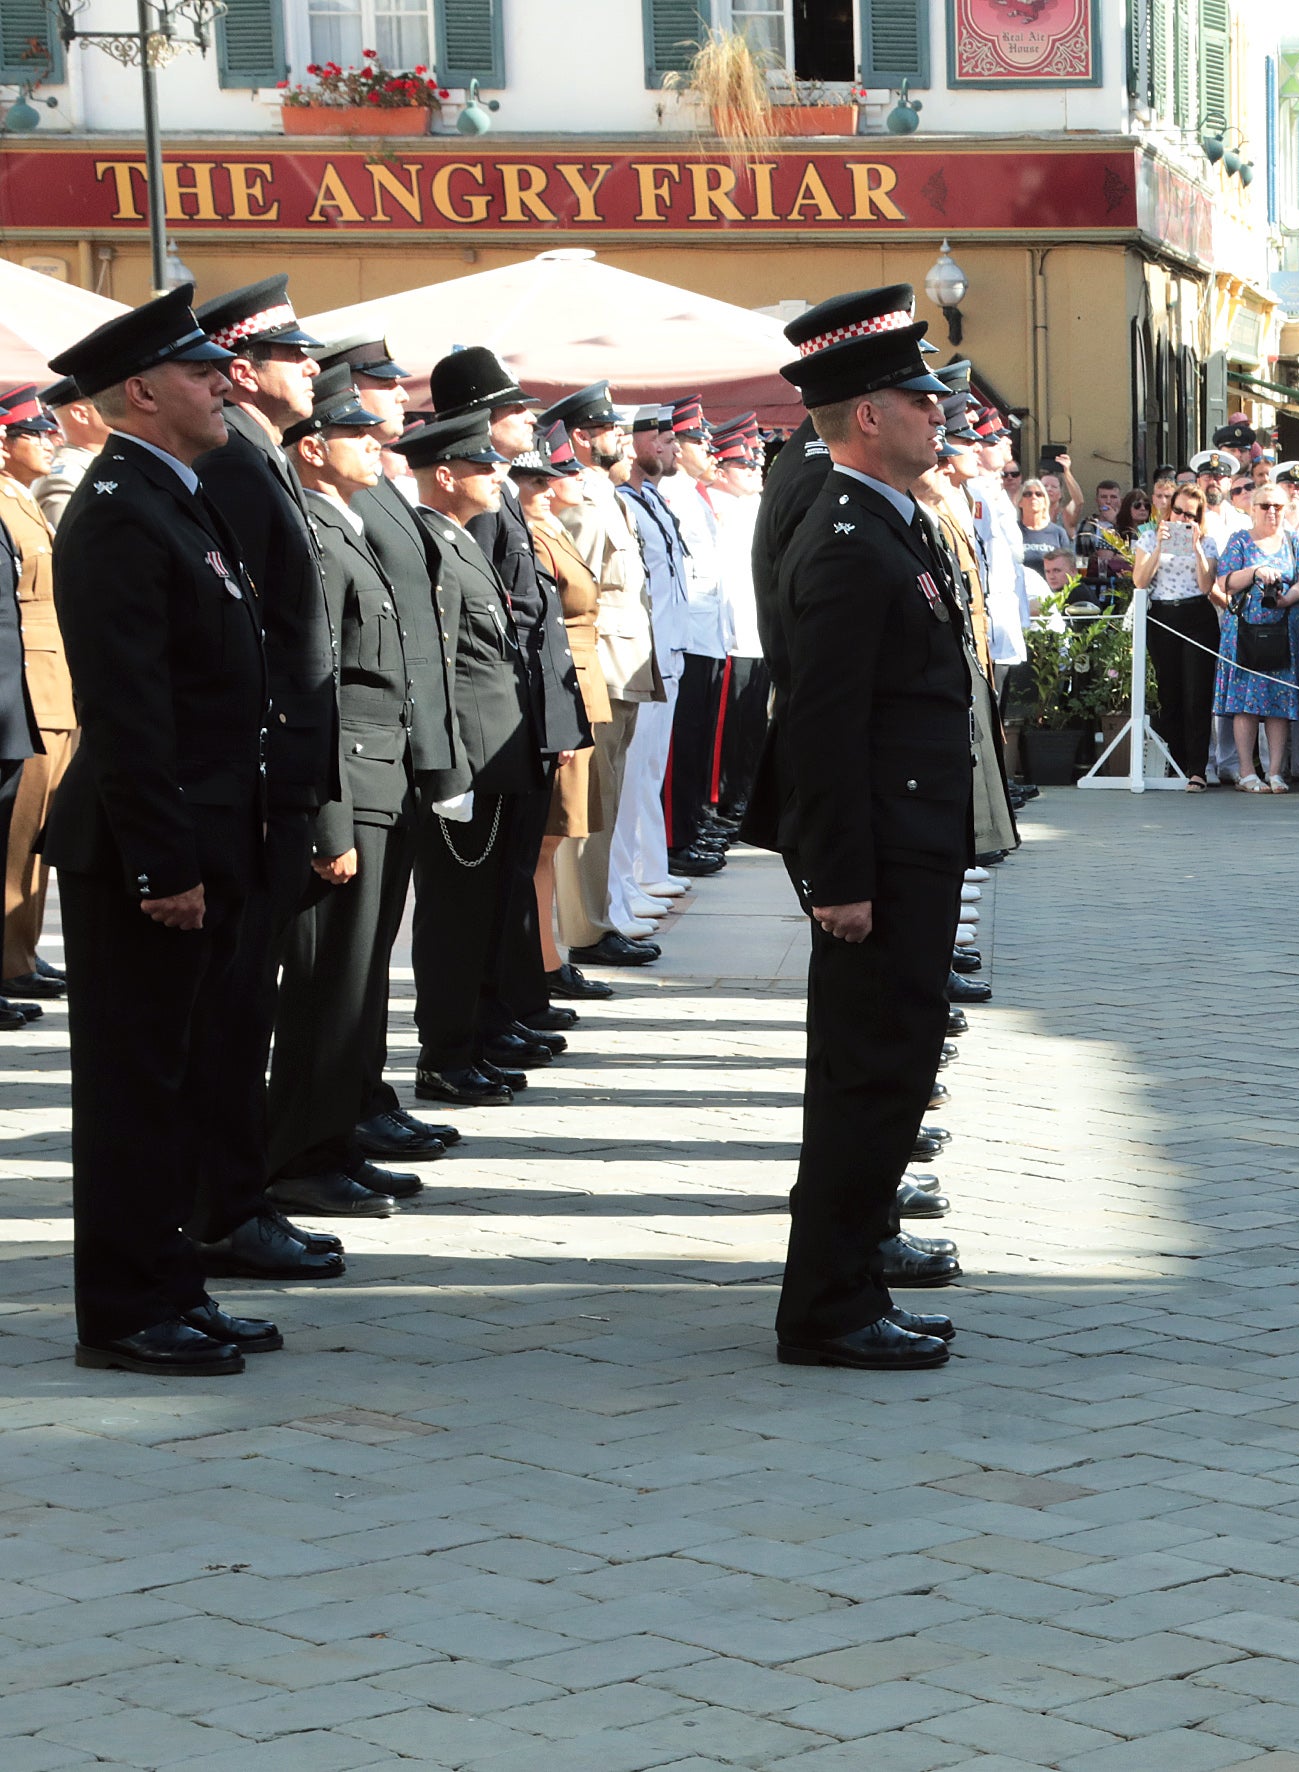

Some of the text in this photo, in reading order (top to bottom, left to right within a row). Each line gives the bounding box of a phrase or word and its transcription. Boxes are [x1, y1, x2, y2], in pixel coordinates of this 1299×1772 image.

[1002, 31, 1046, 41] Real Ale
[1008, 43, 1040, 53] House
[95, 161, 907, 222] THE ANGRY FRIAR
